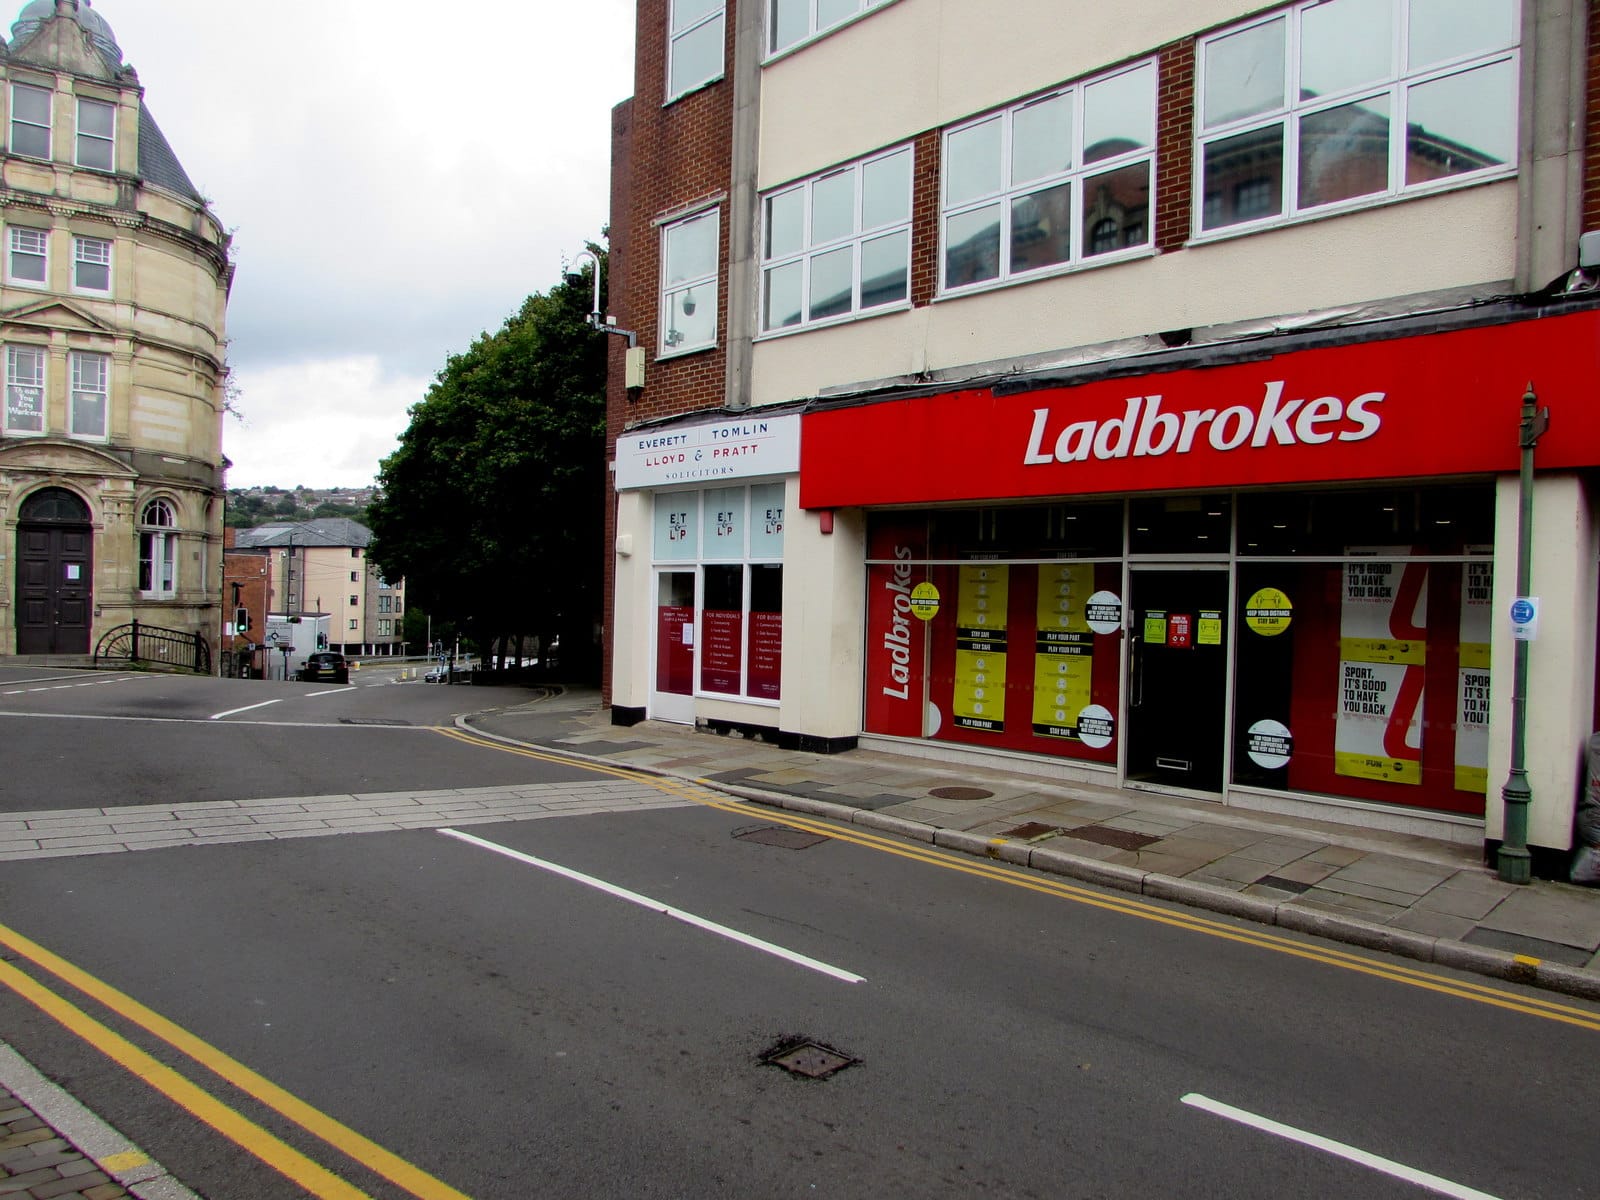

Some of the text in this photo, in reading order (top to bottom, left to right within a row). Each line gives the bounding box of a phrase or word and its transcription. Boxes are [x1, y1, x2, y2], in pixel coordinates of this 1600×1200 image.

[1023, 380, 1386, 465] Ladbrokes
[639, 423, 768, 450] EVERETT TOMLIN
[646, 444, 758, 467] LLOYD & PRATT
[665, 467, 734, 479] SOLICITORS
[1348, 563, 1392, 574] IT'S GOOD
[1348, 575, 1385, 585] TO HAVE
[1348, 586, 1392, 597] YOU BACK
[1468, 588, 1488, 599] YOU
[883, 545, 912, 700] Ladbrokes
[1345, 666, 1375, 679] SPORT,
[1344, 678, 1386, 692] IT'S GOOD
[1465, 674, 1490, 687] SPOR
[1344, 689, 1379, 703] TO HAVE
[1464, 687, 1483, 698] IT'S
[1344, 701, 1386, 715] YOU BACK
[1464, 699, 1476, 710] TO
[1463, 711, 1483, 723] YOU
